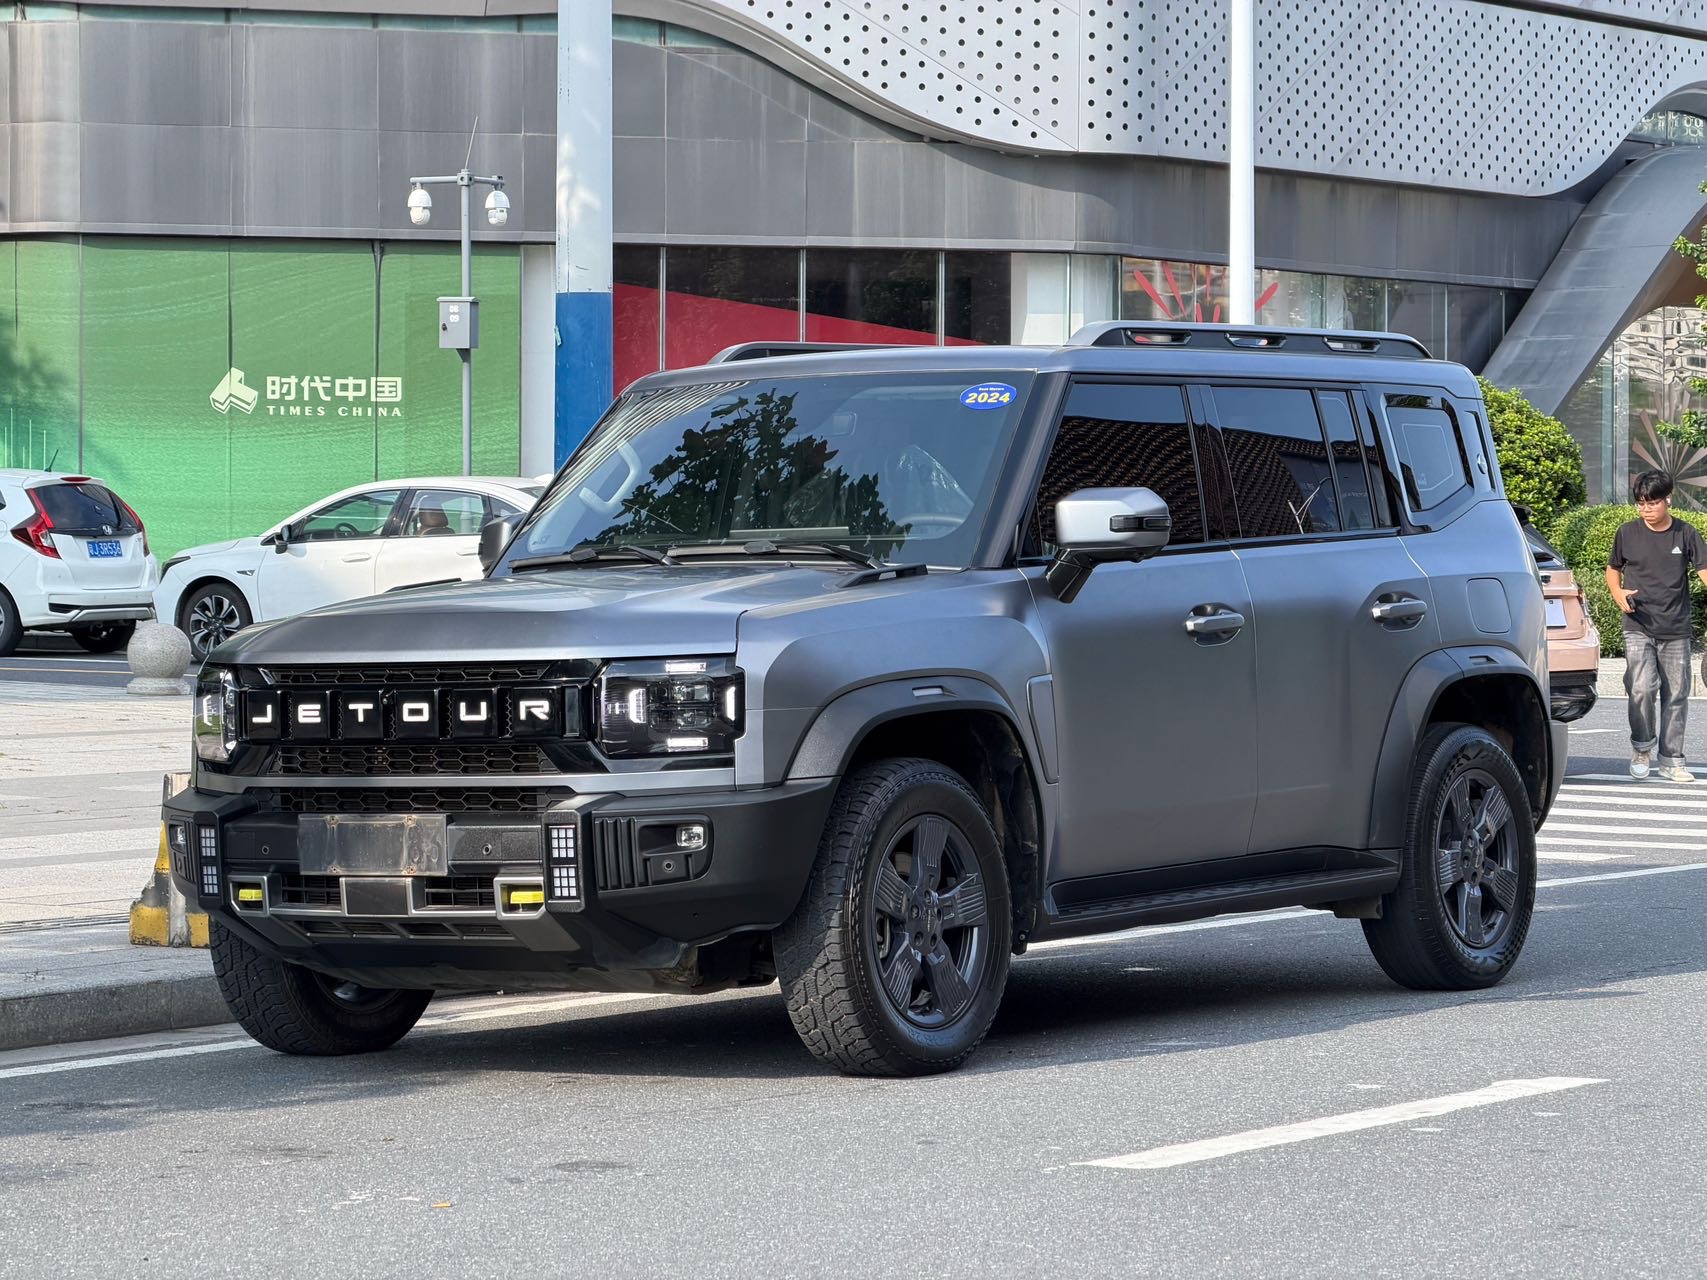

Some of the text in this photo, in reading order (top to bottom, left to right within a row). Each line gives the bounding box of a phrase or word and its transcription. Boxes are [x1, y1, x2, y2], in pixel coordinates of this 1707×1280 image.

[266, 375, 403, 402] 时代中国
[965, 392, 1011, 404] 2024
[266, 405, 402, 417] TIMES CHINA
[252, 699, 550, 724] JETOUR
